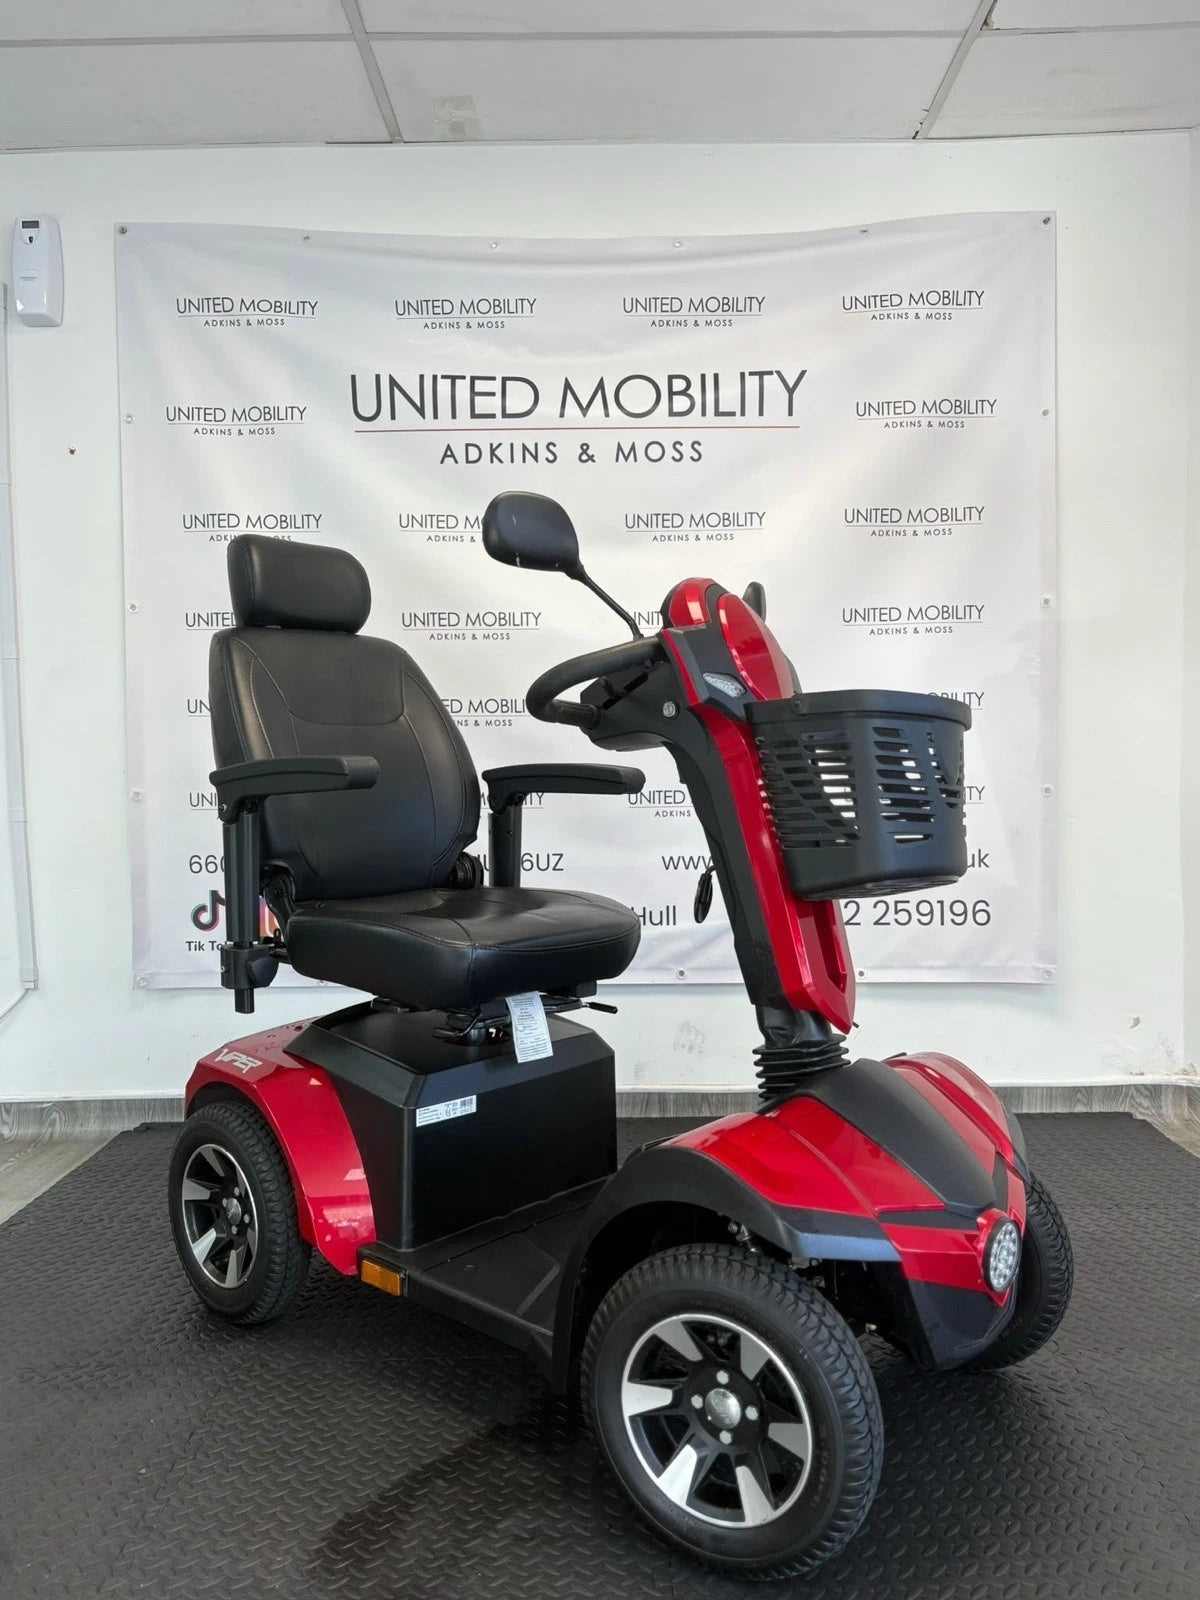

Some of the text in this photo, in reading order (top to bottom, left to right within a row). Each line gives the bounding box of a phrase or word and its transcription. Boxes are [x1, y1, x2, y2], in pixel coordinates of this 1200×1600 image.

[176, 297, 318, 315] UNITED MOBILITY
[395, 298, 537, 316] UNITED MOBILITY
[623, 296, 765, 313] UNITED MOBILITY
[843, 290, 985, 310] UNITED MOBILITY
[203, 318, 285, 328] ADKINS & MOSS
[651, 319, 733, 328] ADKINS & MOSS
[871, 311, 953, 322] ADKINS & MOSS
[423, 321, 506, 330] ADKINS & MOSS
[350, 370, 807, 422] UNITED MOBILITY
[166, 406, 306, 422] UNITED MOBILITY
[856, 399, 997, 417] UNITED MOBILITY
[193, 427, 276, 437] ADKINS & MOSS
[884, 420, 965, 429] ADKINS & MOSS
[440, 441, 702, 464] ADKINS & MOSS
[183, 513, 322, 529] UNITED MOBILITY
[399, 514, 458, 529] UNITED
[625, 512, 765, 529] UNITED MOBILITY
[845, 506, 985, 523] UNITED MOBILITY
[427, 535, 477, 543] ADKINS &
[652, 533, 735, 543] ADKINS & MOSS
[871, 528, 953, 538] ADKINS & MOSS
[402, 612, 541, 627] UNITED MOBILITY
[843, 605, 985, 623] UNITED MOBILITY
[429, 632, 511, 641] ADKINS & MOSS
[869, 626, 954, 637] ADKINS & MOSS
[473, 719, 481, 728] &
[485, 719, 513, 728] MOSS
[628, 791, 685, 805] UNITED
[655, 810, 692, 818] ADKINS
[521, 853, 564, 872] 6UZ
[630, 905, 677, 926] Hull
[873, 900, 991, 926] 259196
[186, 941, 205, 951] Tik
